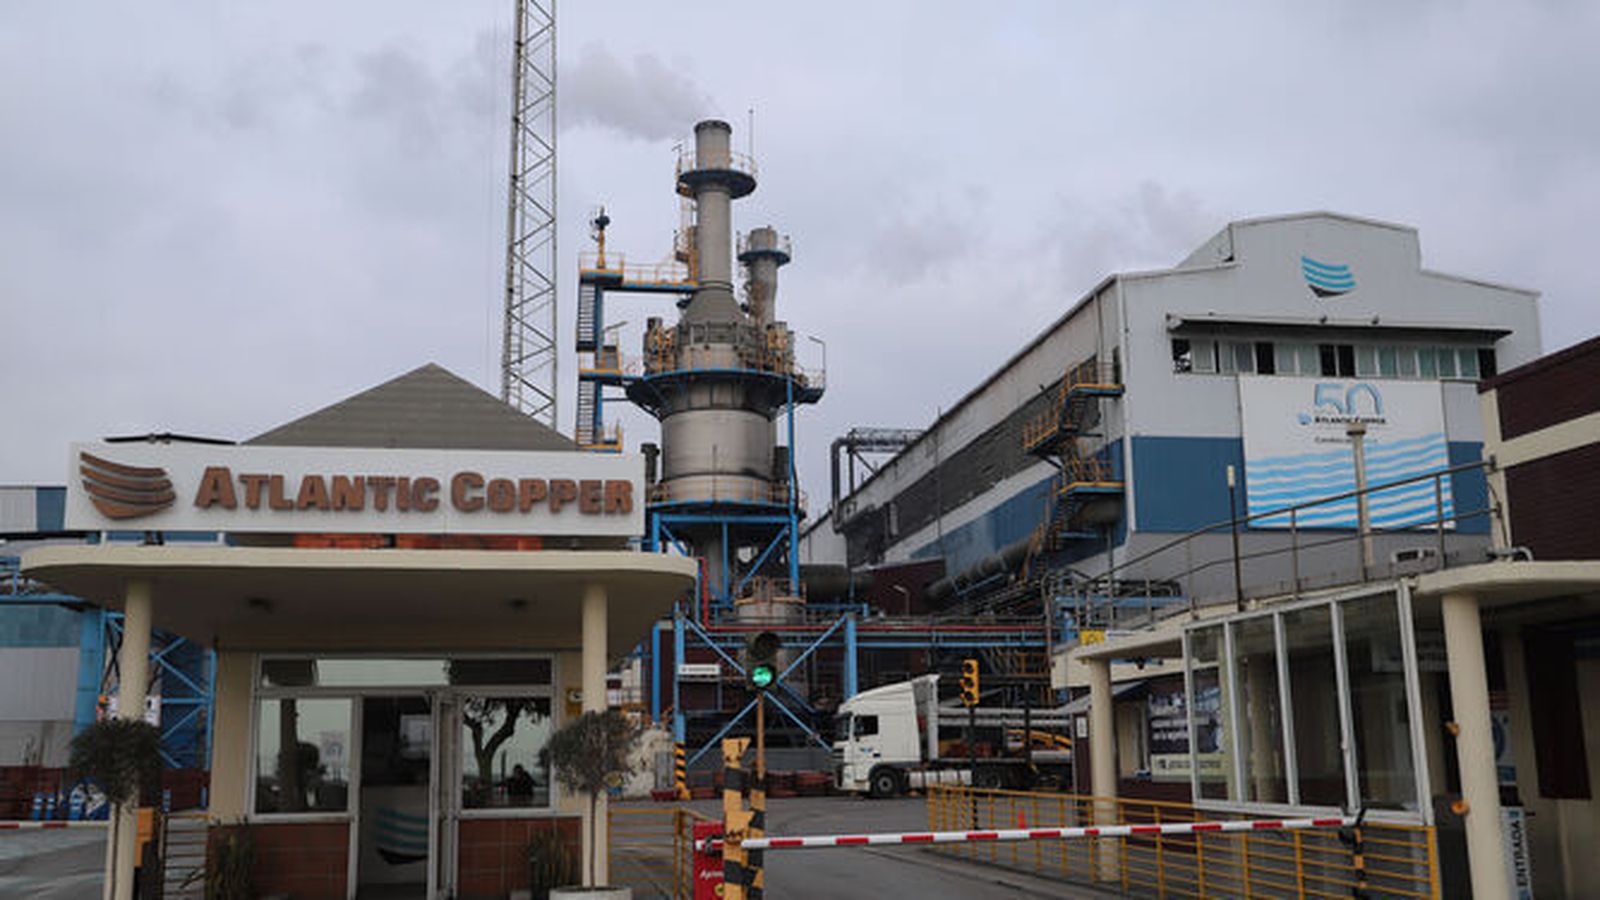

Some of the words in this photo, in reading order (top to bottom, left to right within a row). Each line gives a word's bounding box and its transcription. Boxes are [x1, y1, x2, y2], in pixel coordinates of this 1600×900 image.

[194, 466, 441, 511] ATLANTIC
[449, 471, 634, 515] COPPER
[1511, 820, 1527, 886] ENTRADA
